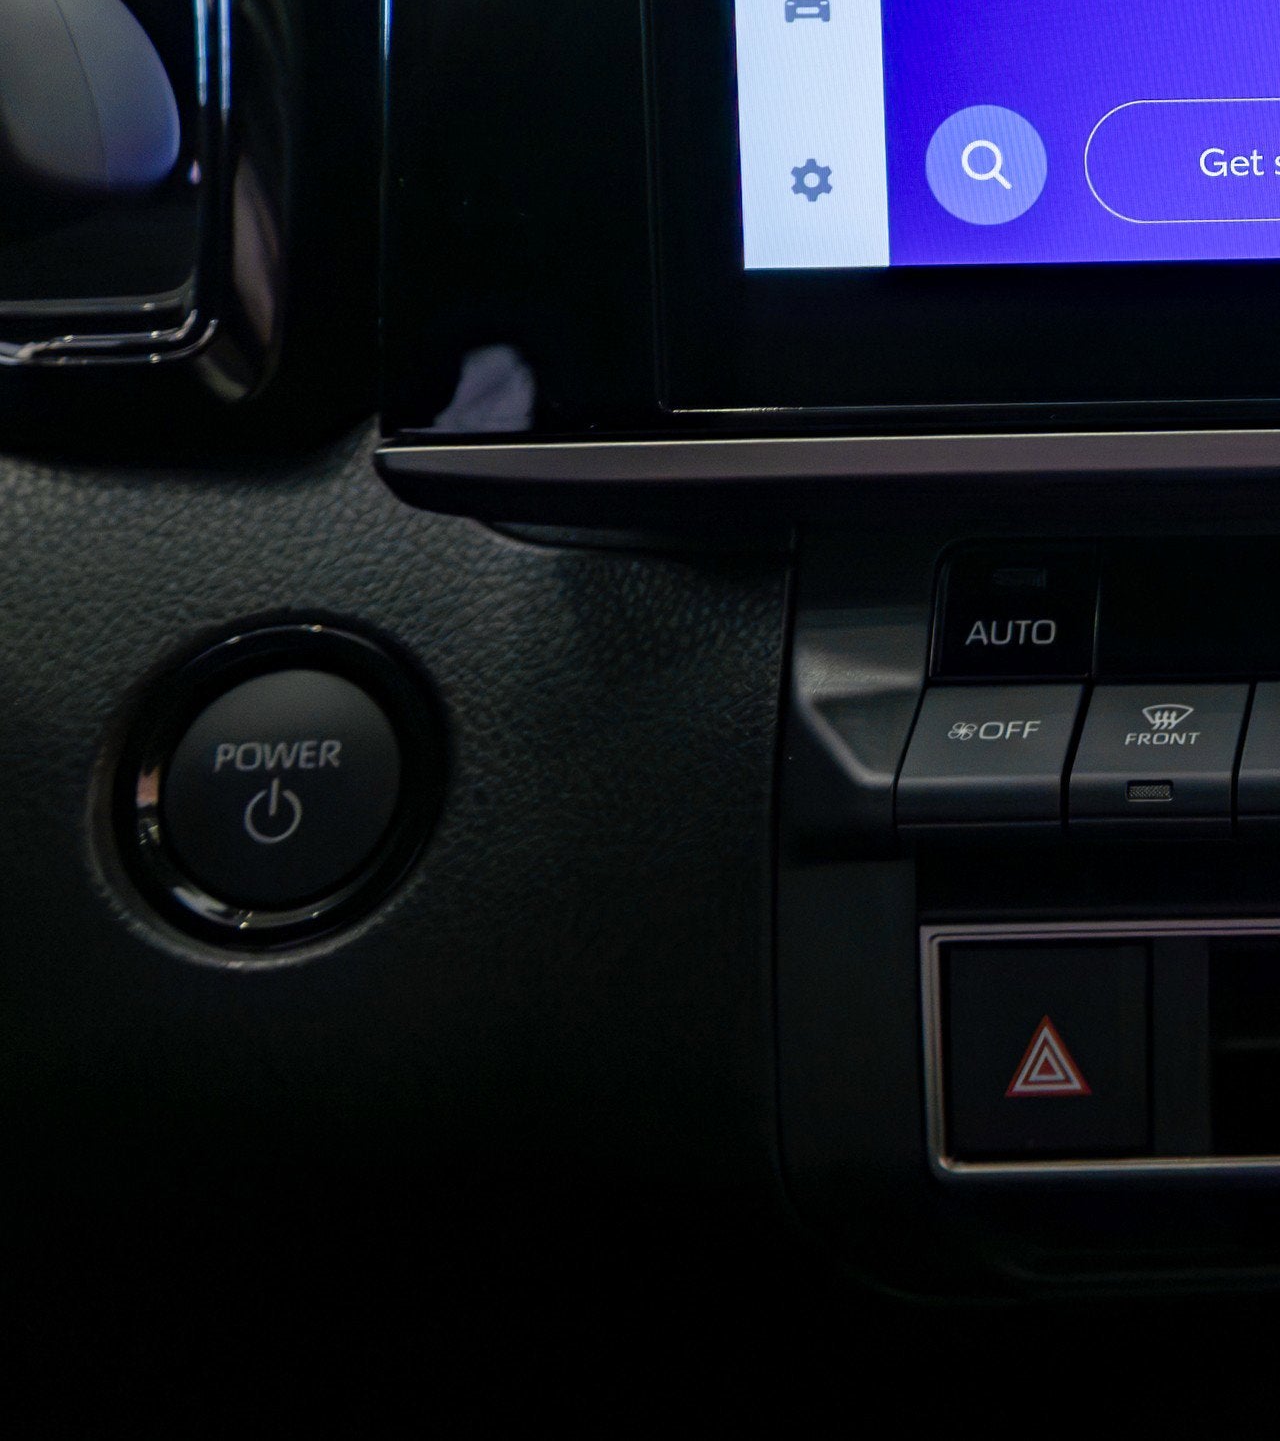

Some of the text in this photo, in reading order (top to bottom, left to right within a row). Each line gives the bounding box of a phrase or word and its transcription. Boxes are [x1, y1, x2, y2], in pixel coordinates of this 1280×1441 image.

[1199, 148, 1264, 177] Get
[965, 619, 1056, 645] AUTO
[979, 720, 1041, 741] OFF
[1125, 731, 1200, 746] FRONT
[213, 739, 343, 772] POWER
